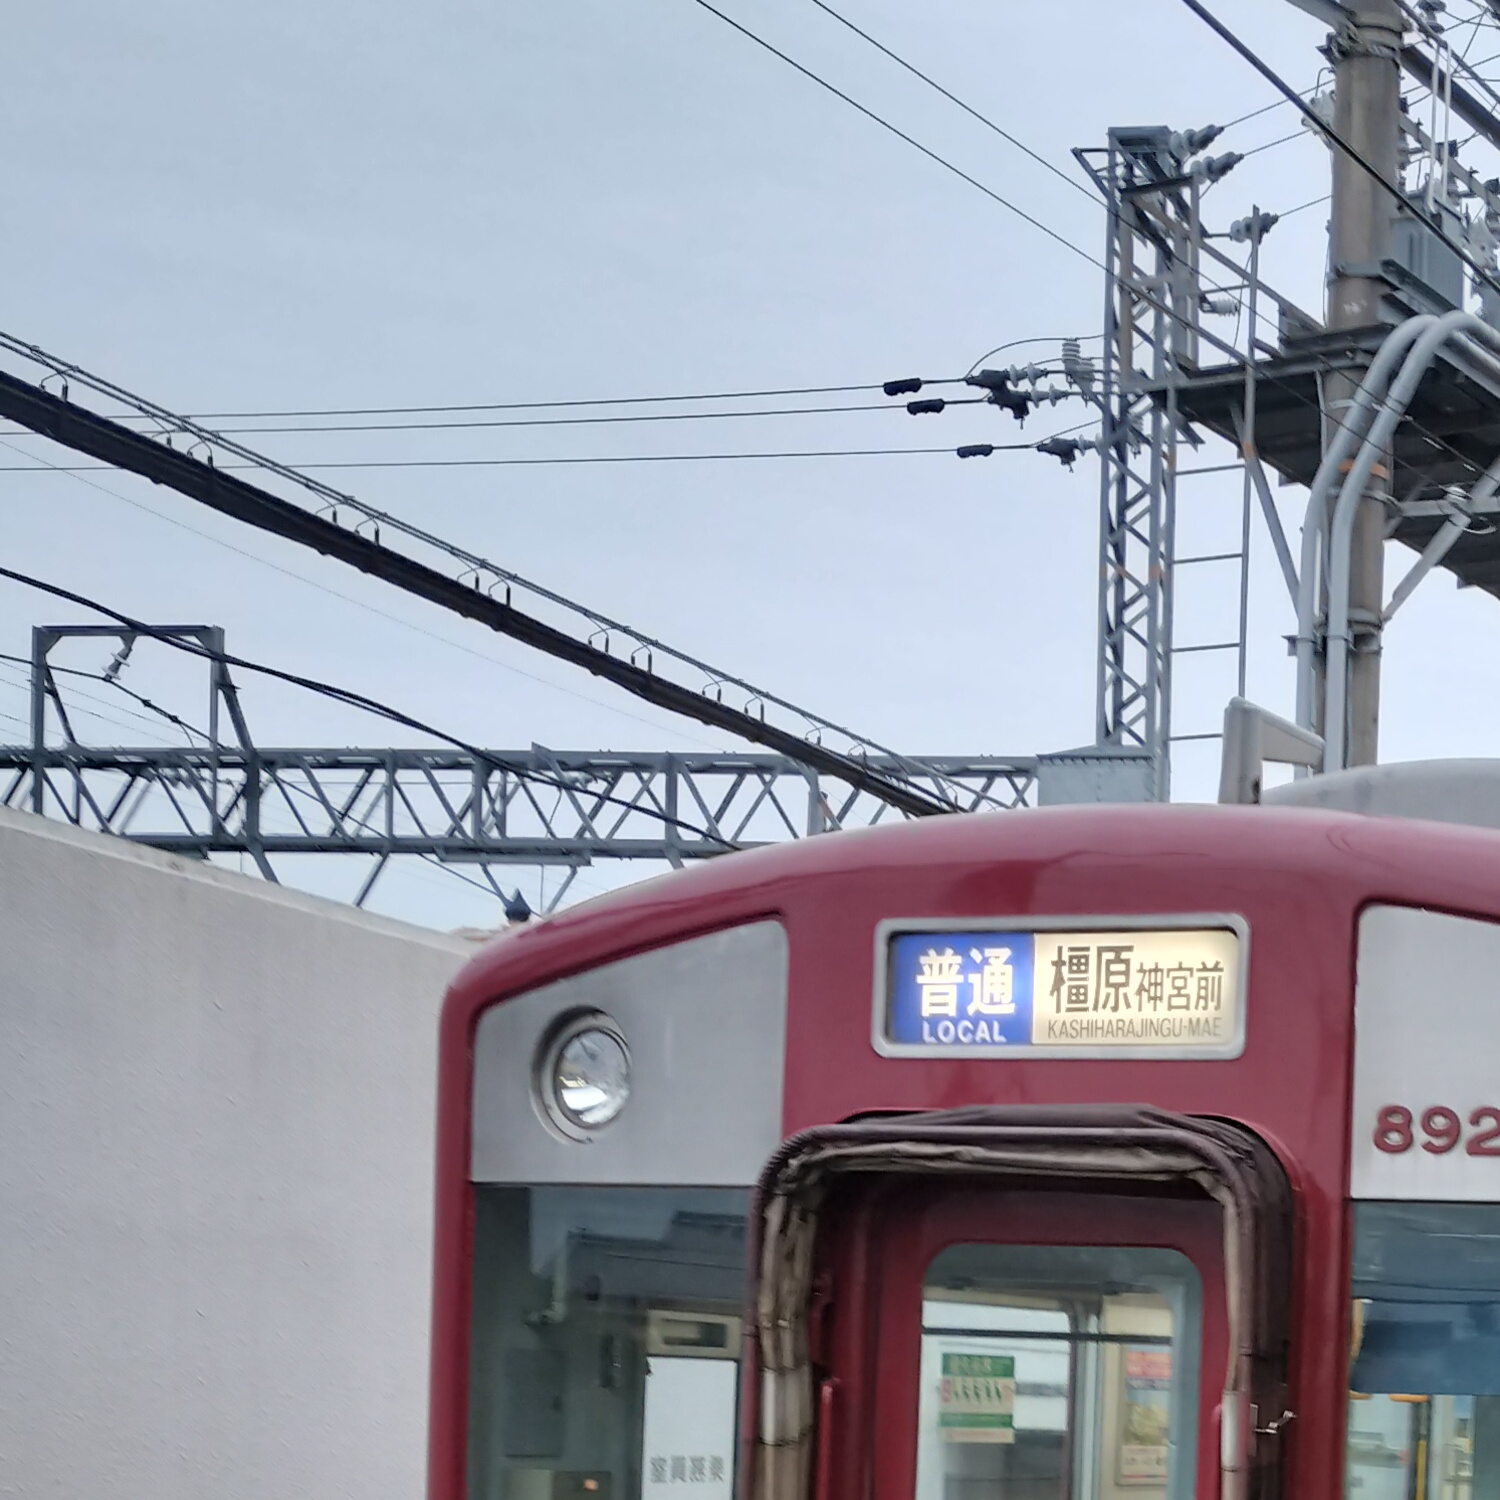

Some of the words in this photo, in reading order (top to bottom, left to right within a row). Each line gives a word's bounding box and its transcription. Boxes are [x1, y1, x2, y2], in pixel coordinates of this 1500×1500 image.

[916, 947, 1016, 1017] 普通
[1049, 945, 1225, 1014] 橿原神宮前
[922, 1020, 1007, 1044] LOCAL
[1047, 1016, 1223, 1039] KASHIHARAJINGU-MAE
